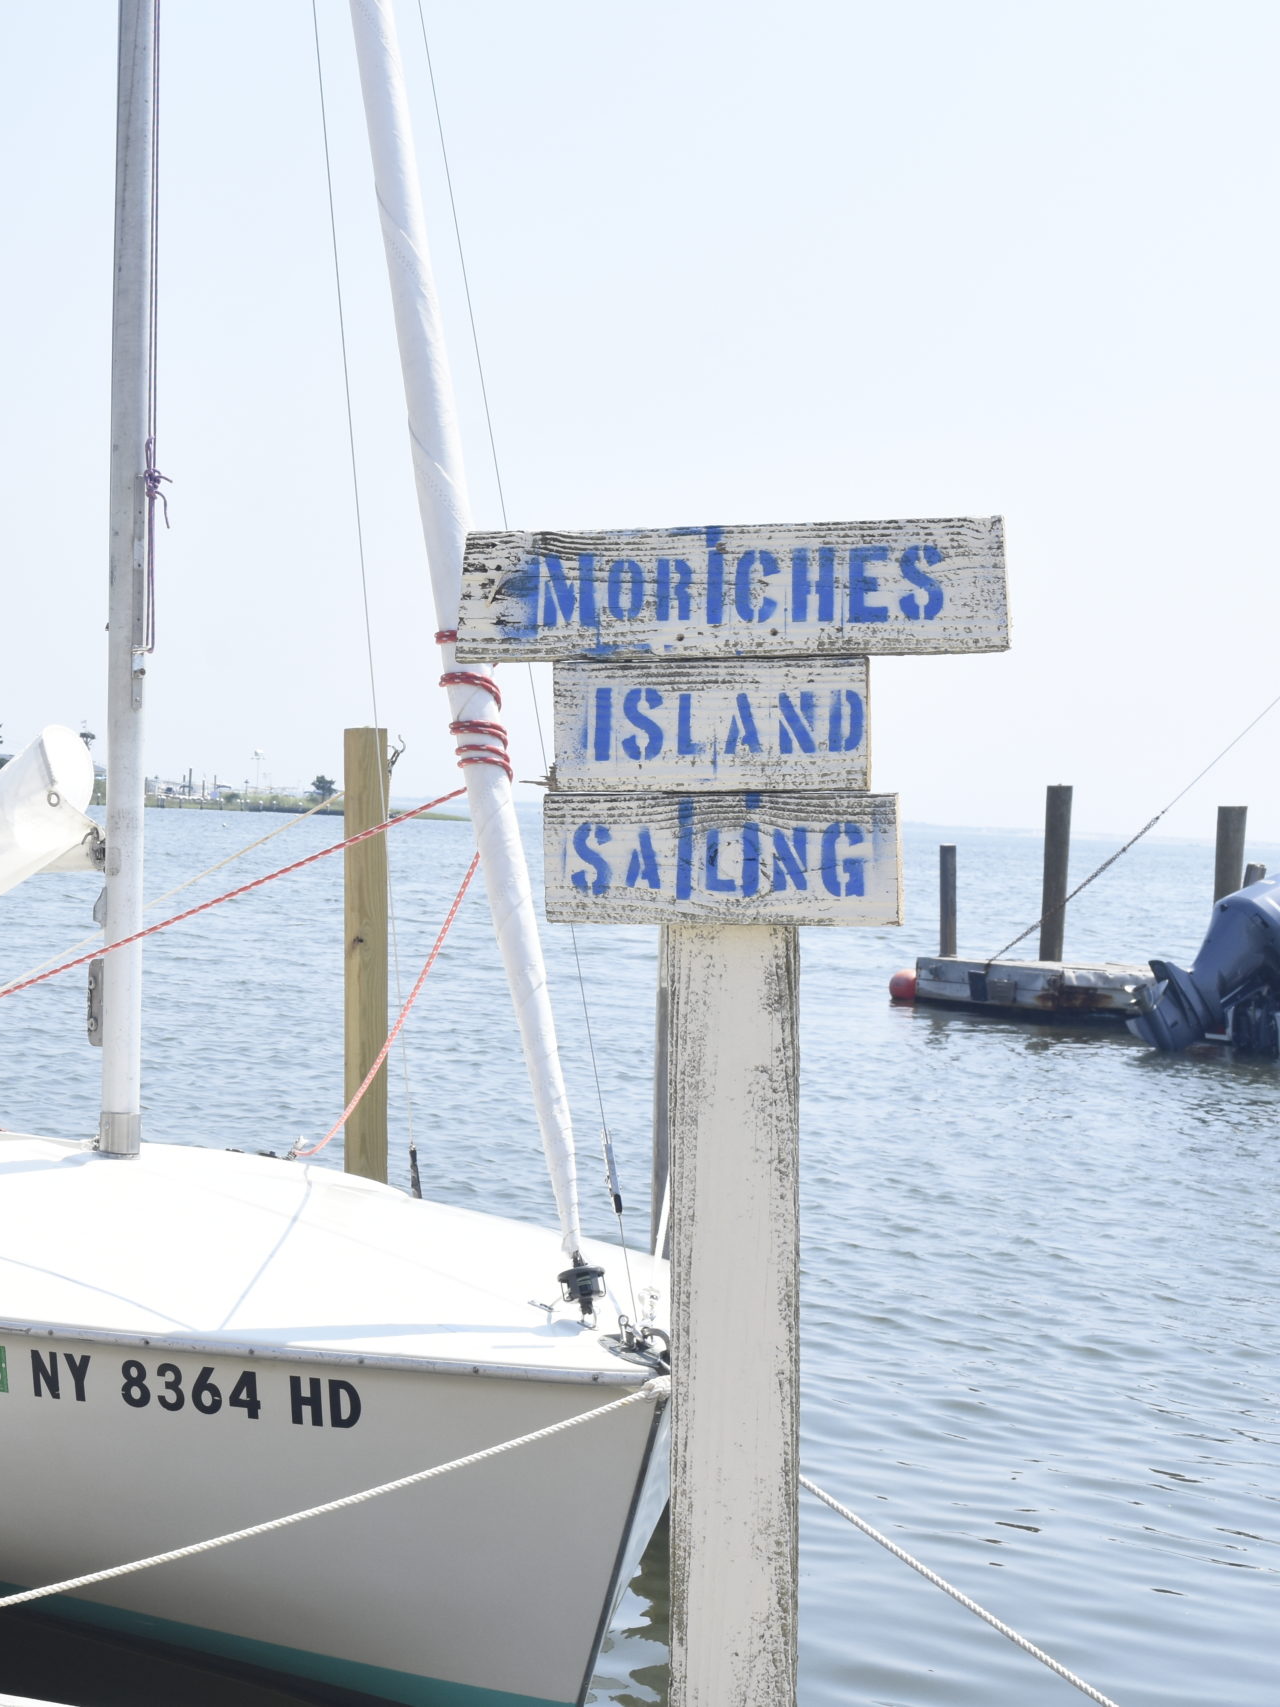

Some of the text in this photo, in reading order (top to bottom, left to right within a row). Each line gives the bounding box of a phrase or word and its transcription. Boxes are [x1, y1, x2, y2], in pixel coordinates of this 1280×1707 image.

[542, 543, 944, 627] MORICHES
[594, 688, 863, 761] ISLAND
[571, 800, 865, 899] SAILING
[31, 1349, 362, 1429] NY 8364 HD
